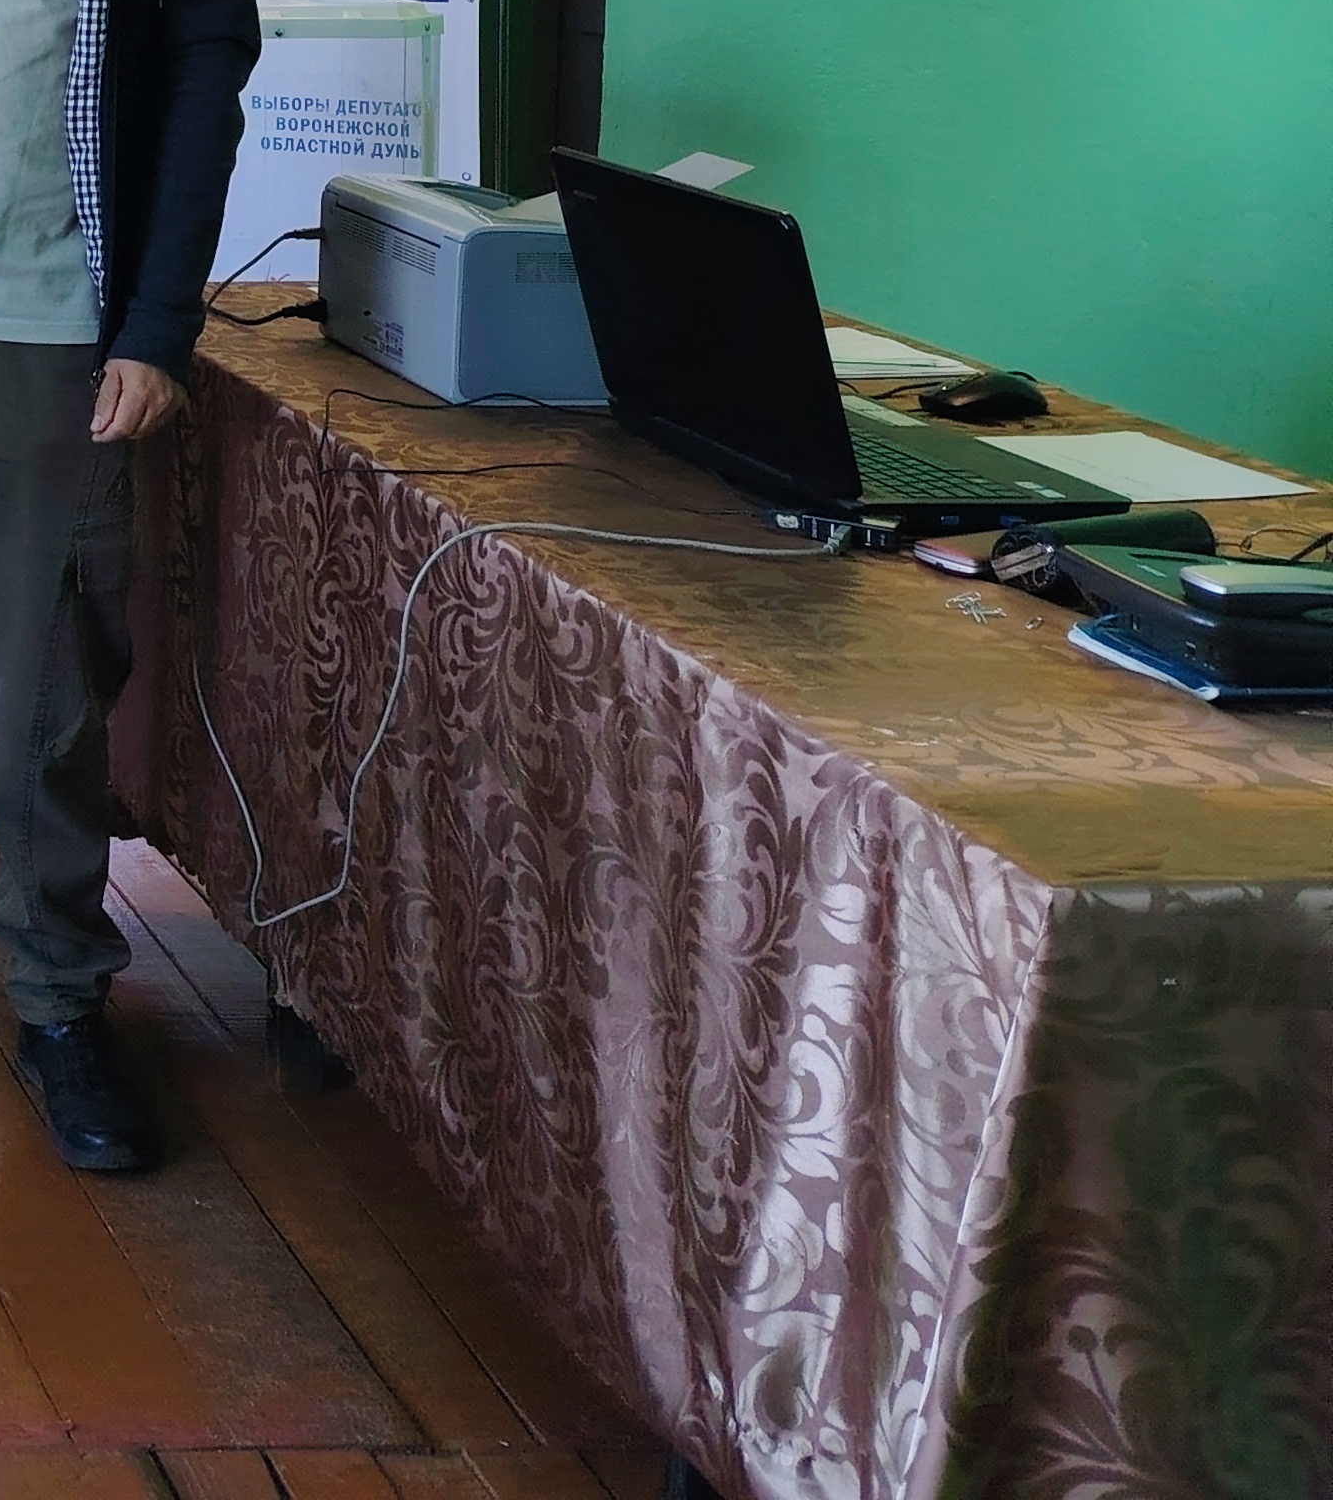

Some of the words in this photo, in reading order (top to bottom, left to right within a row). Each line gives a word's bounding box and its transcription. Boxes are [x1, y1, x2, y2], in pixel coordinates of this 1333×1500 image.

[251, 96, 329, 113] ВЫБОРЫ
[276, 117, 410, 138] ВОРОНЕЖСКОЙ
[261, 137, 365, 156] ОБЛАСТНОЙ
